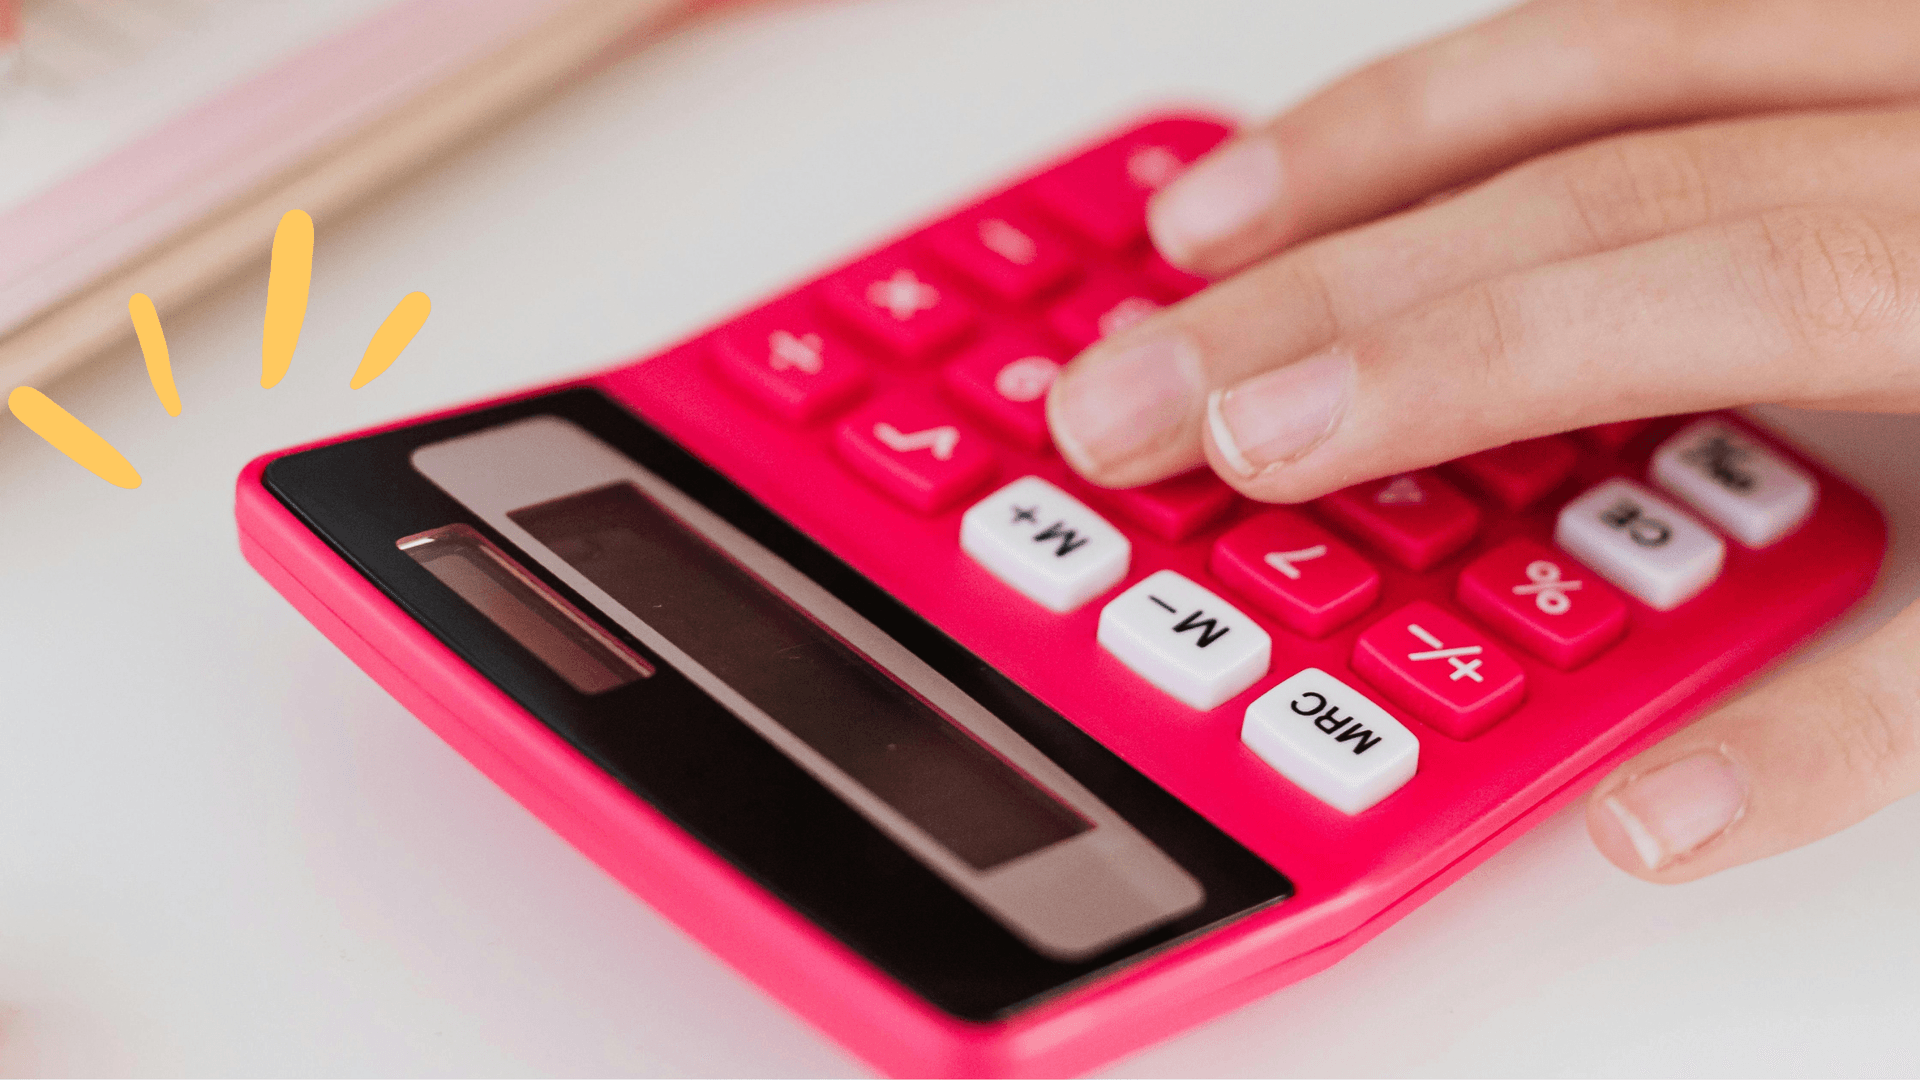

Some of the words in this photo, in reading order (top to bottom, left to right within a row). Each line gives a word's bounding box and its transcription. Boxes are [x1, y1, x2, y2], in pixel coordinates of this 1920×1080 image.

[1009, 504, 1089, 557] M+
[1265, 545, 1327, 580] 7
[1512, 560, 1583, 615] %
[1148, 594, 1231, 649] M-
[1290, 691, 1383, 755] MRC
